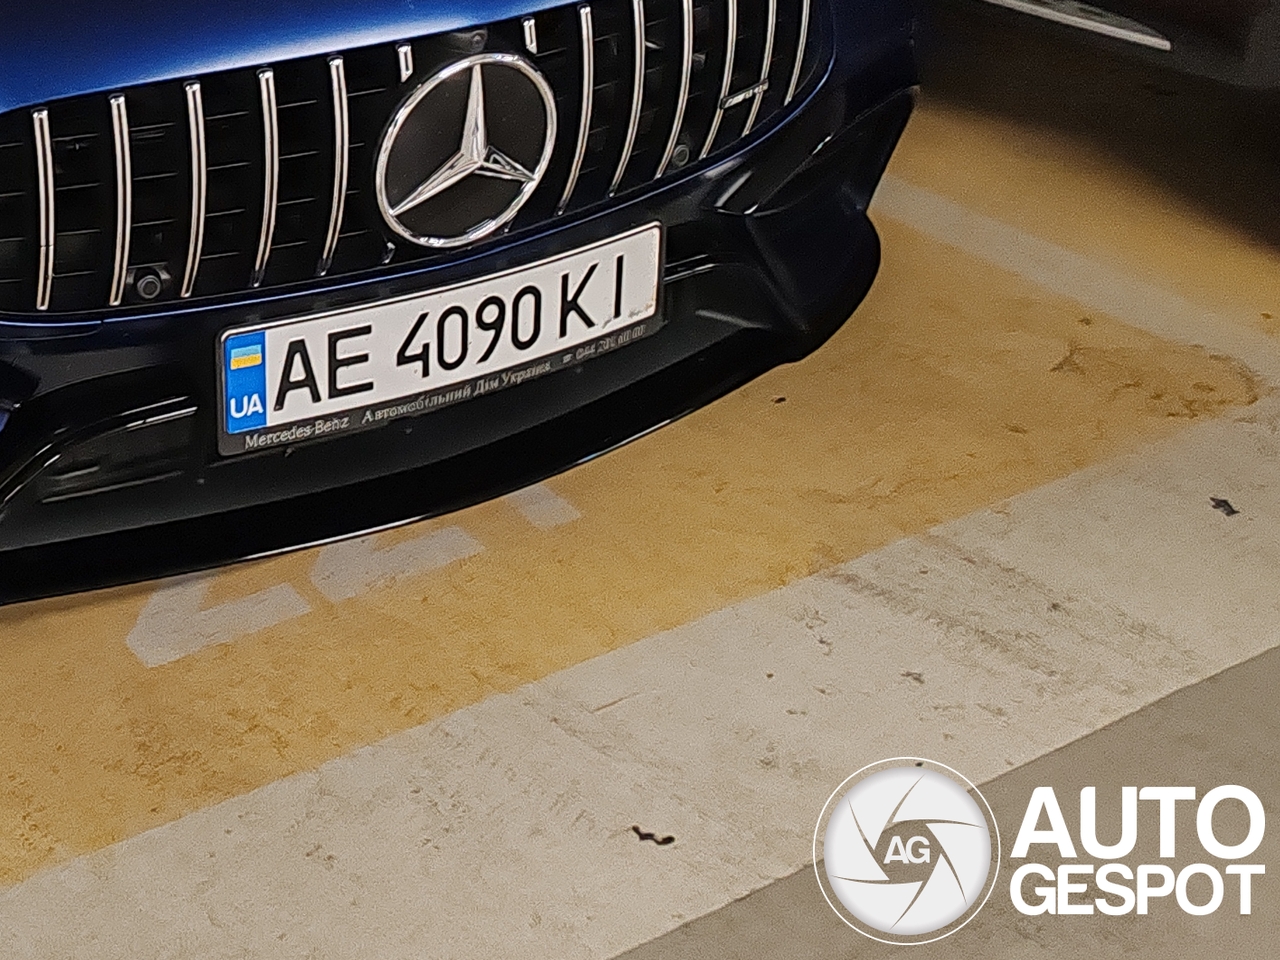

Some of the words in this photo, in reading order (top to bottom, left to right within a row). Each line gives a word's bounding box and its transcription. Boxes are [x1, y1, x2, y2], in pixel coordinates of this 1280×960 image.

[274, 324, 374, 412] AE
[397, 285, 542, 379] 4090
[559, 254, 624, 339] KI
[230, 393, 264, 418] UA
[244, 417, 350, 450] Mercedes-Benz
[361, 384, 471, 425] Автомобільний
[473, 376, 499, 397] Дім
